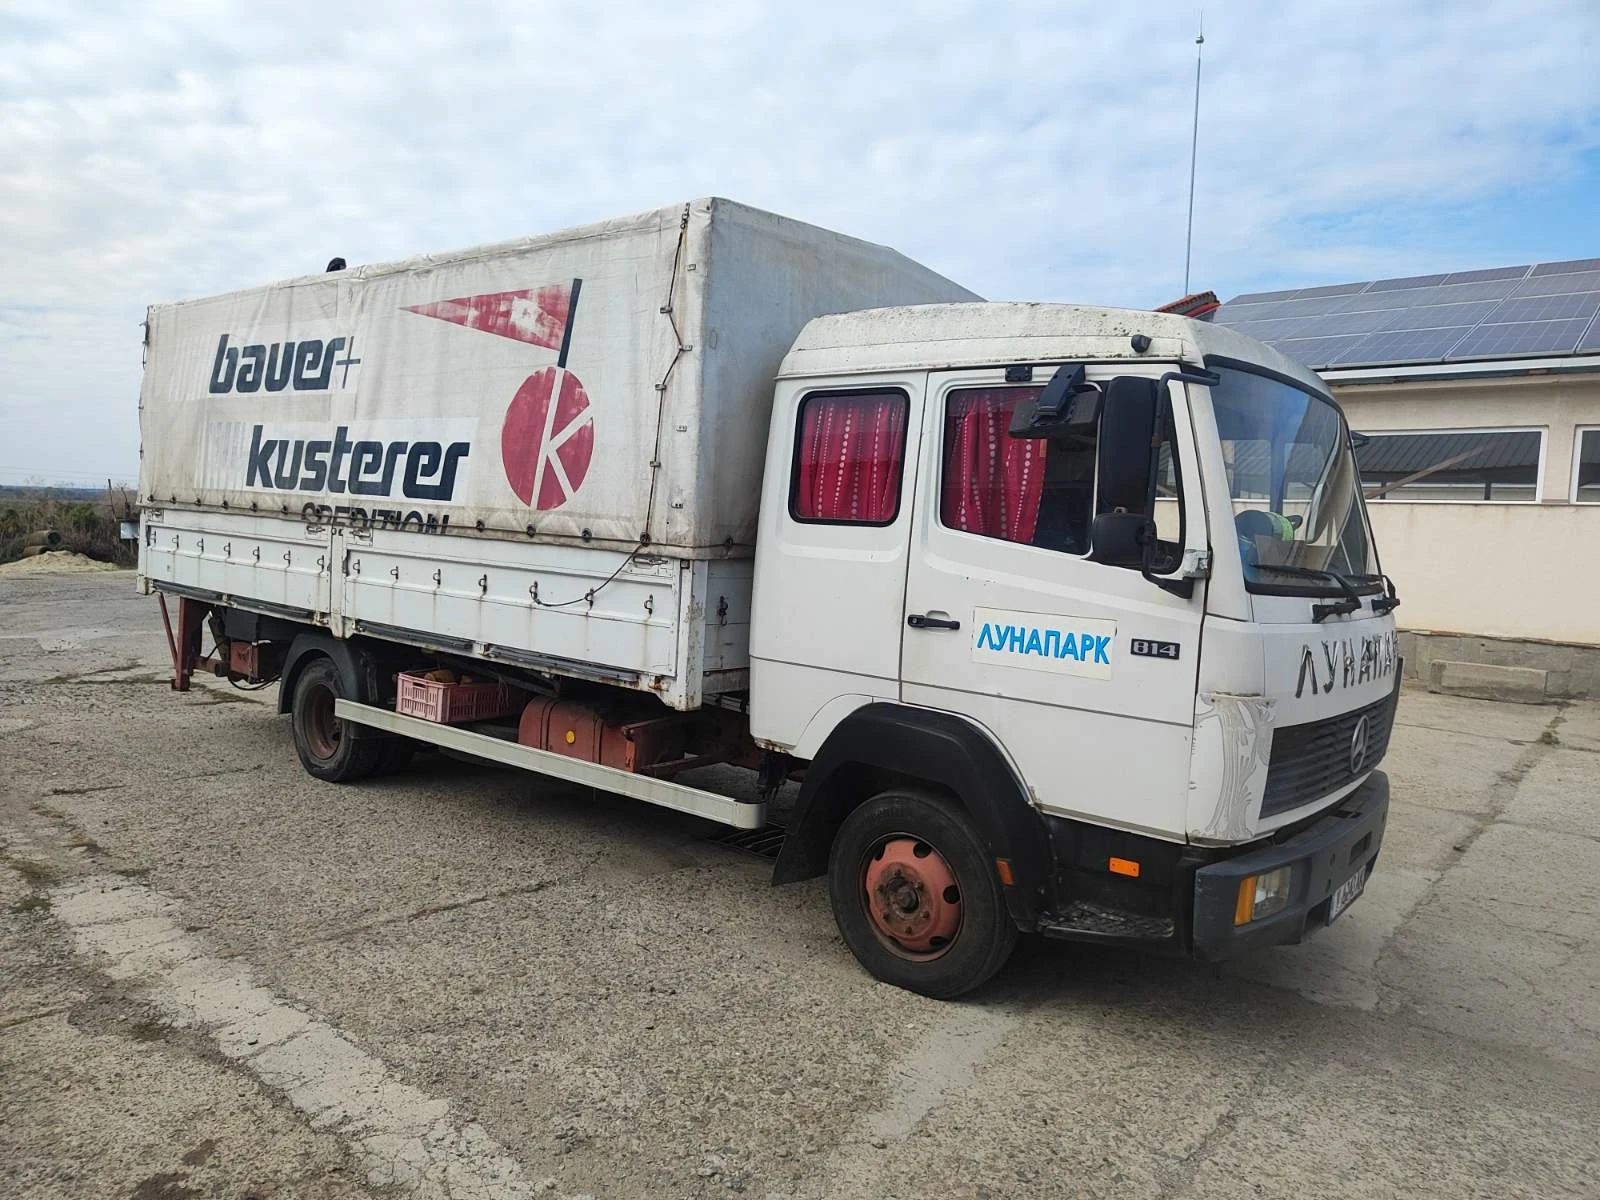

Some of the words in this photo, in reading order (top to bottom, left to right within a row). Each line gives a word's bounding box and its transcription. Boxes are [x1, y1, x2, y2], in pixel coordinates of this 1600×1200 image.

[245, 424, 471, 502] kusterer
[976, 623, 1111, 665] ЛУНАПАРК
[1132, 640, 1177, 657] 814
